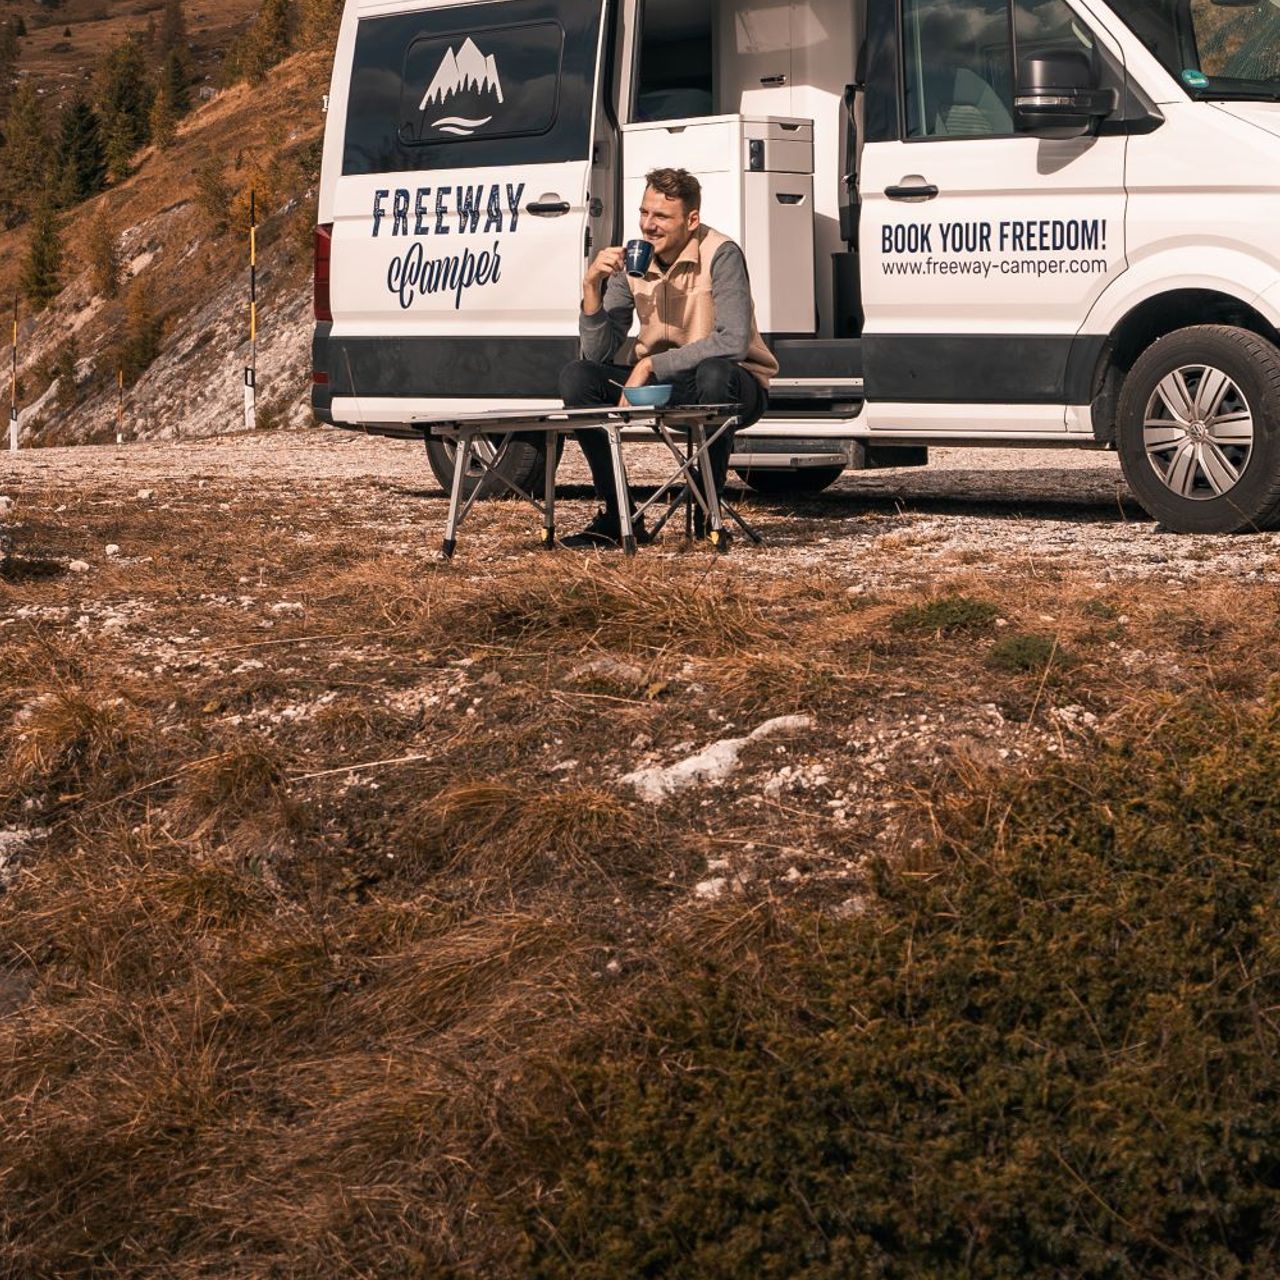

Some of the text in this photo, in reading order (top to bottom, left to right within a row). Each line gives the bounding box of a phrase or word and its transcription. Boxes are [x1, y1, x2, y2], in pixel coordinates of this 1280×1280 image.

[372, 183, 526, 237] FREEWAY
[881, 219, 1107, 254] BOOK YOUR FREEDOM!
[387, 240, 501, 310] Camper
[881, 256, 1108, 278] www.freeway-camper.com
